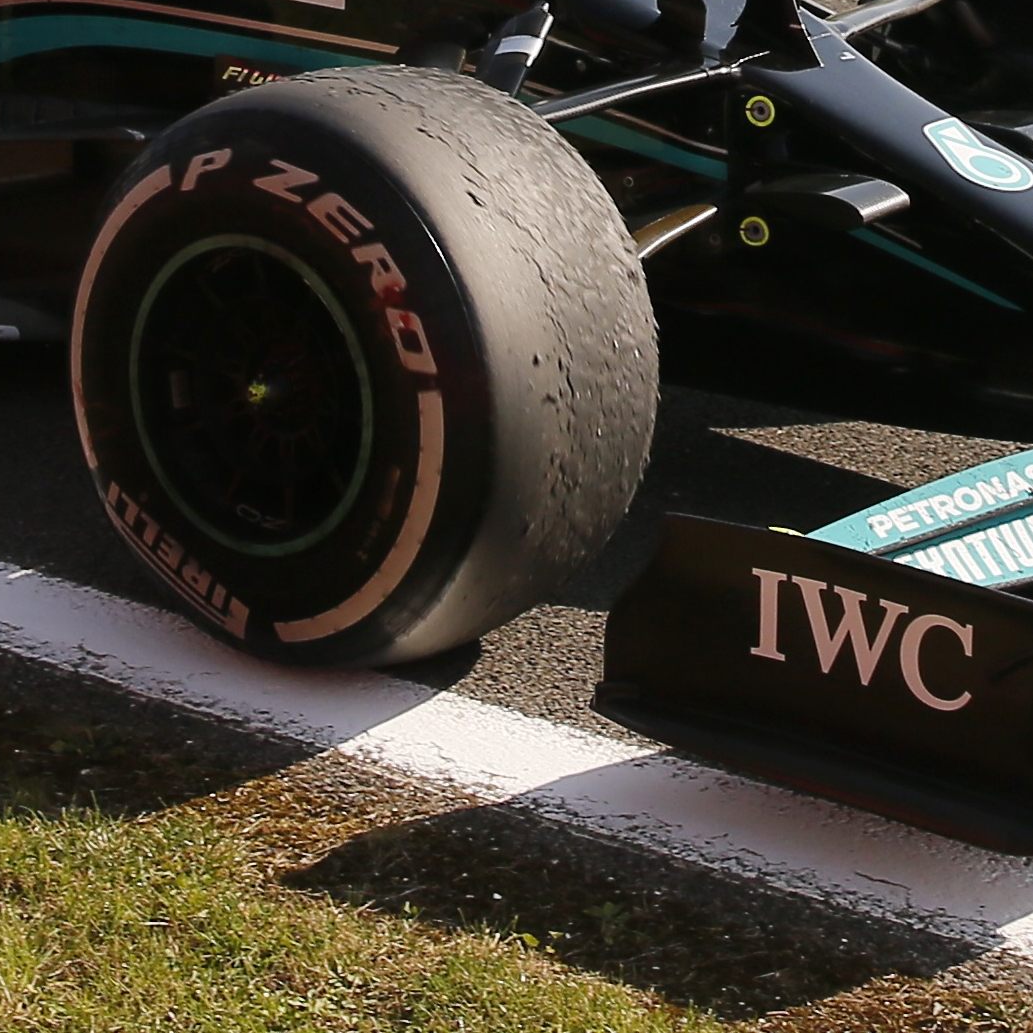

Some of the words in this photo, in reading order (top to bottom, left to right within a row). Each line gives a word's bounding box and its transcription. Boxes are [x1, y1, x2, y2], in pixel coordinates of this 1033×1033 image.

[180, 148, 232, 191] P
[253, 159, 438, 374] ZERO
[750, 567, 974, 711] IWC
